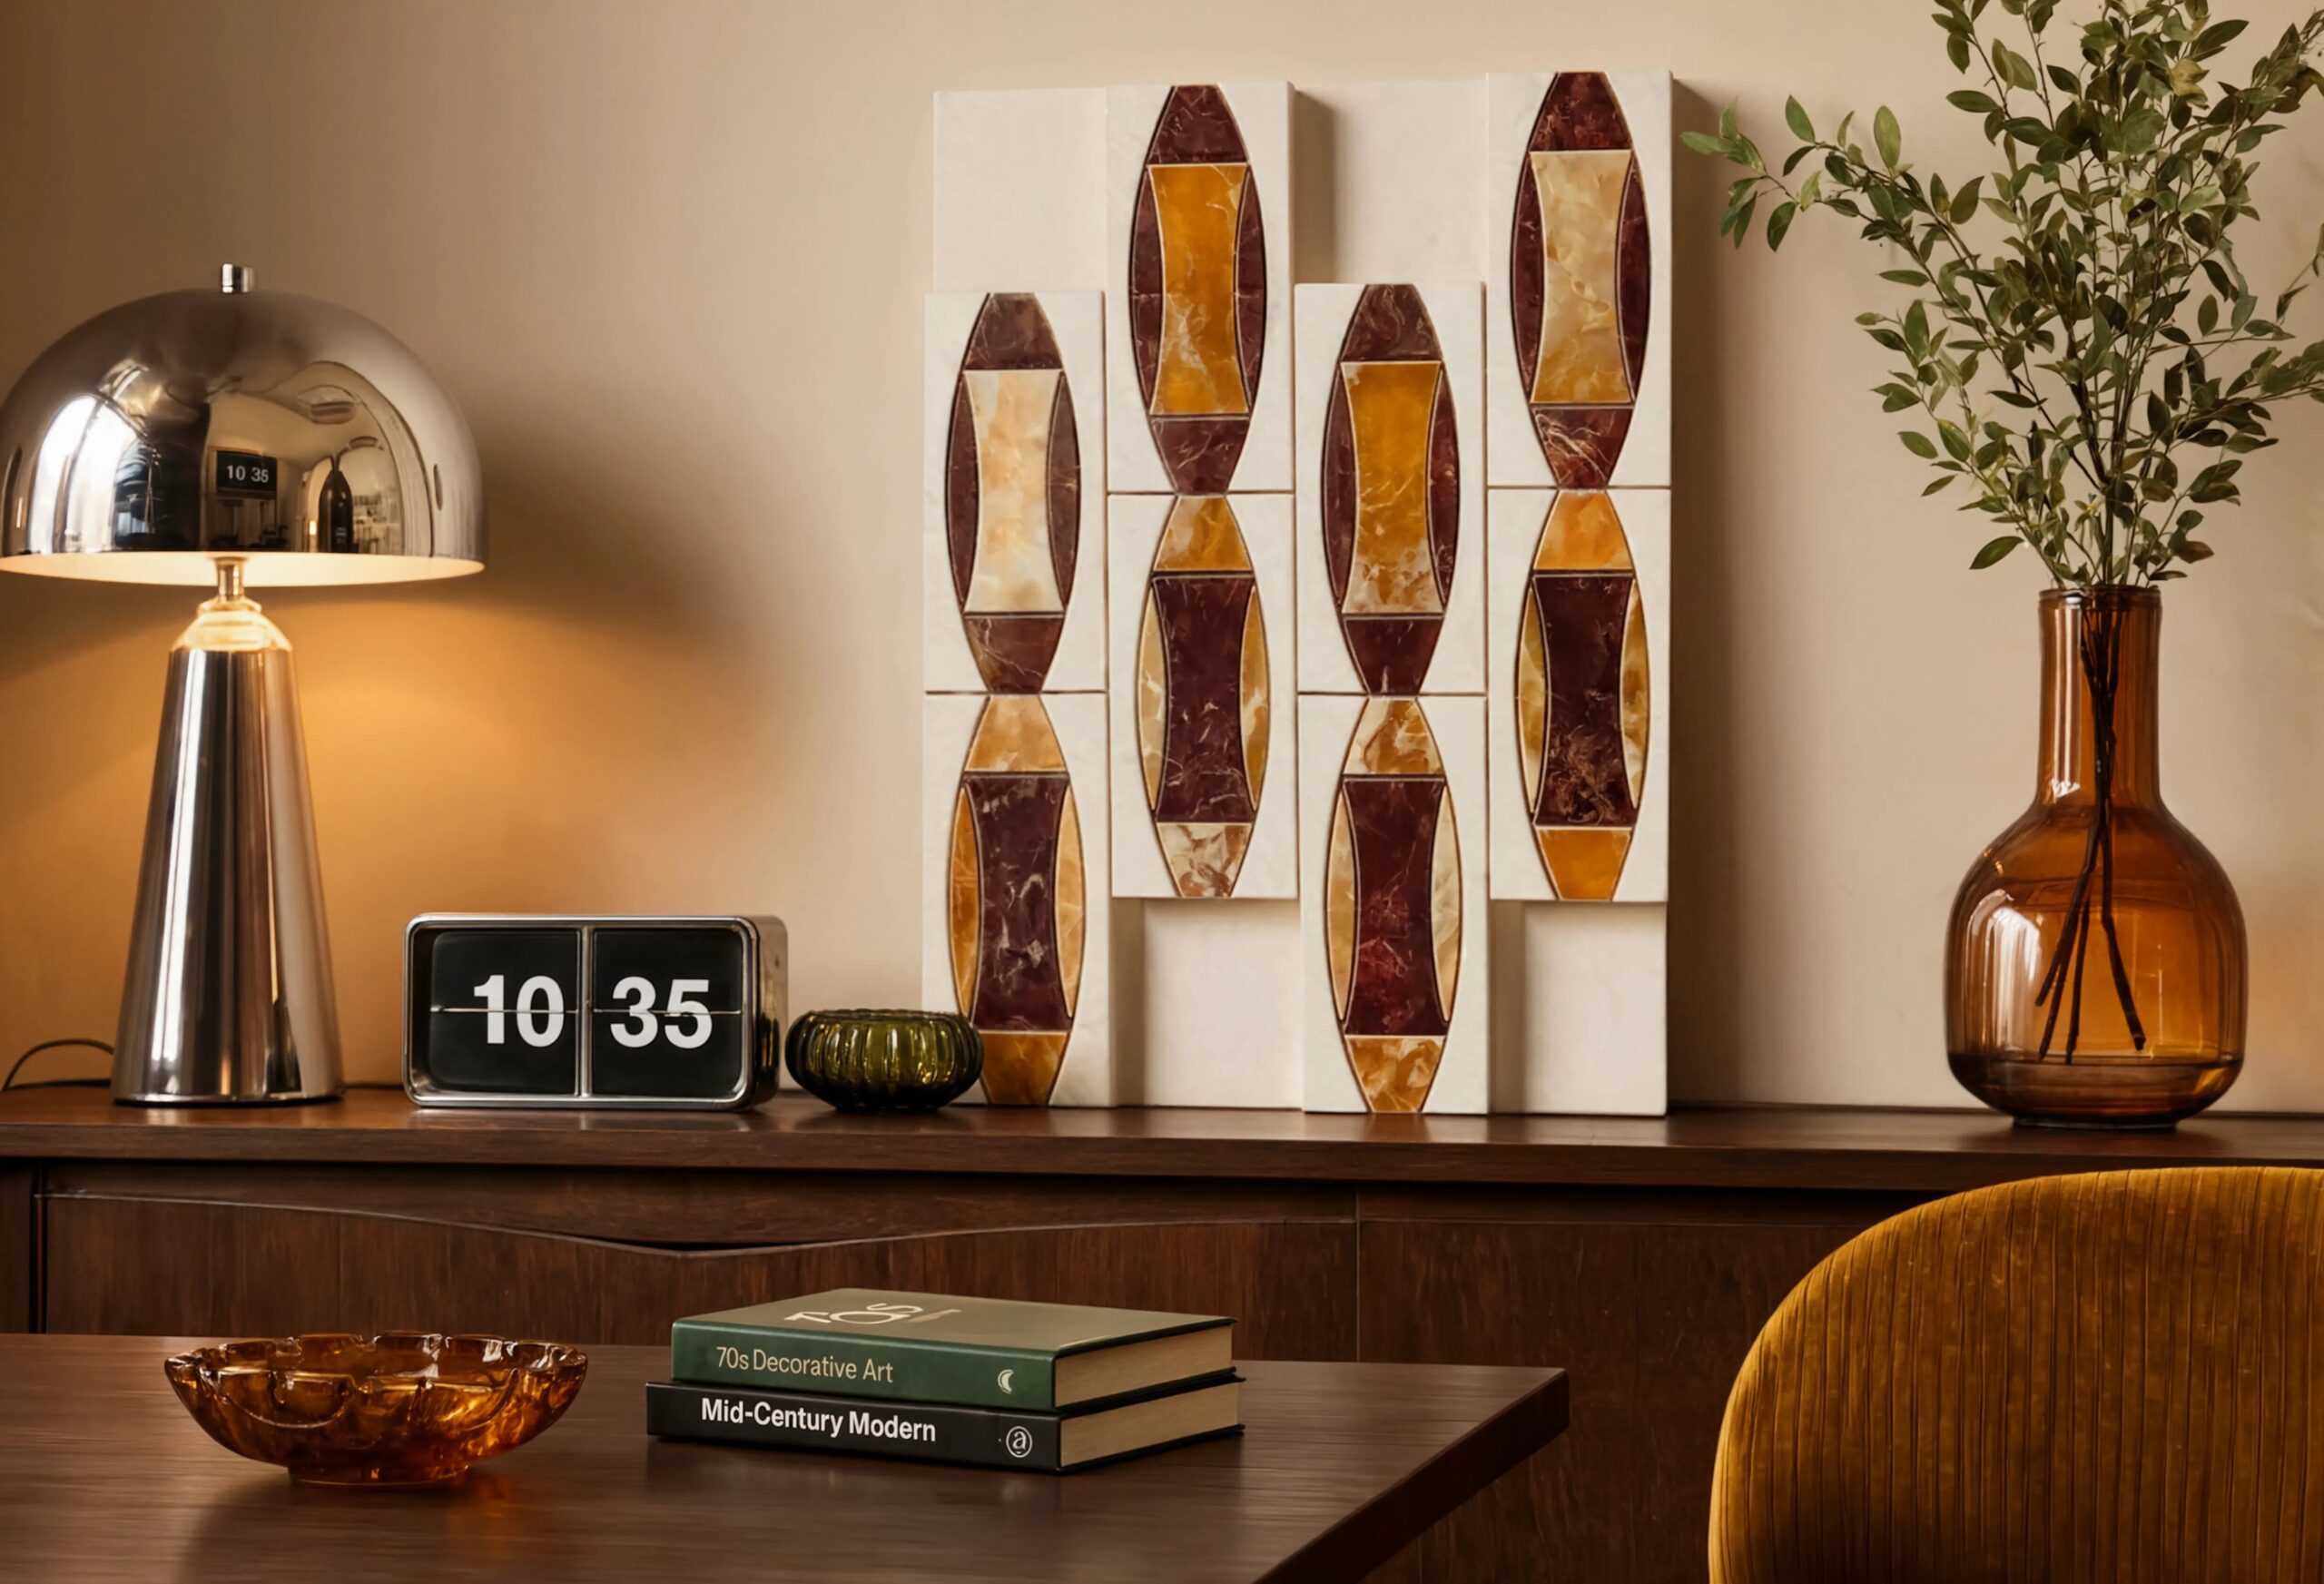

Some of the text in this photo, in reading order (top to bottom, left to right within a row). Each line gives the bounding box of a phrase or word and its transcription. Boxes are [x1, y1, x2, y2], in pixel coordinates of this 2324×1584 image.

[227, 465, 246, 481] 10
[473, 974, 713, 1049] 10 35
[715, 1346, 894, 1383] 70s Decorative Art
[701, 1397, 936, 1442] Mid-Century Modern
